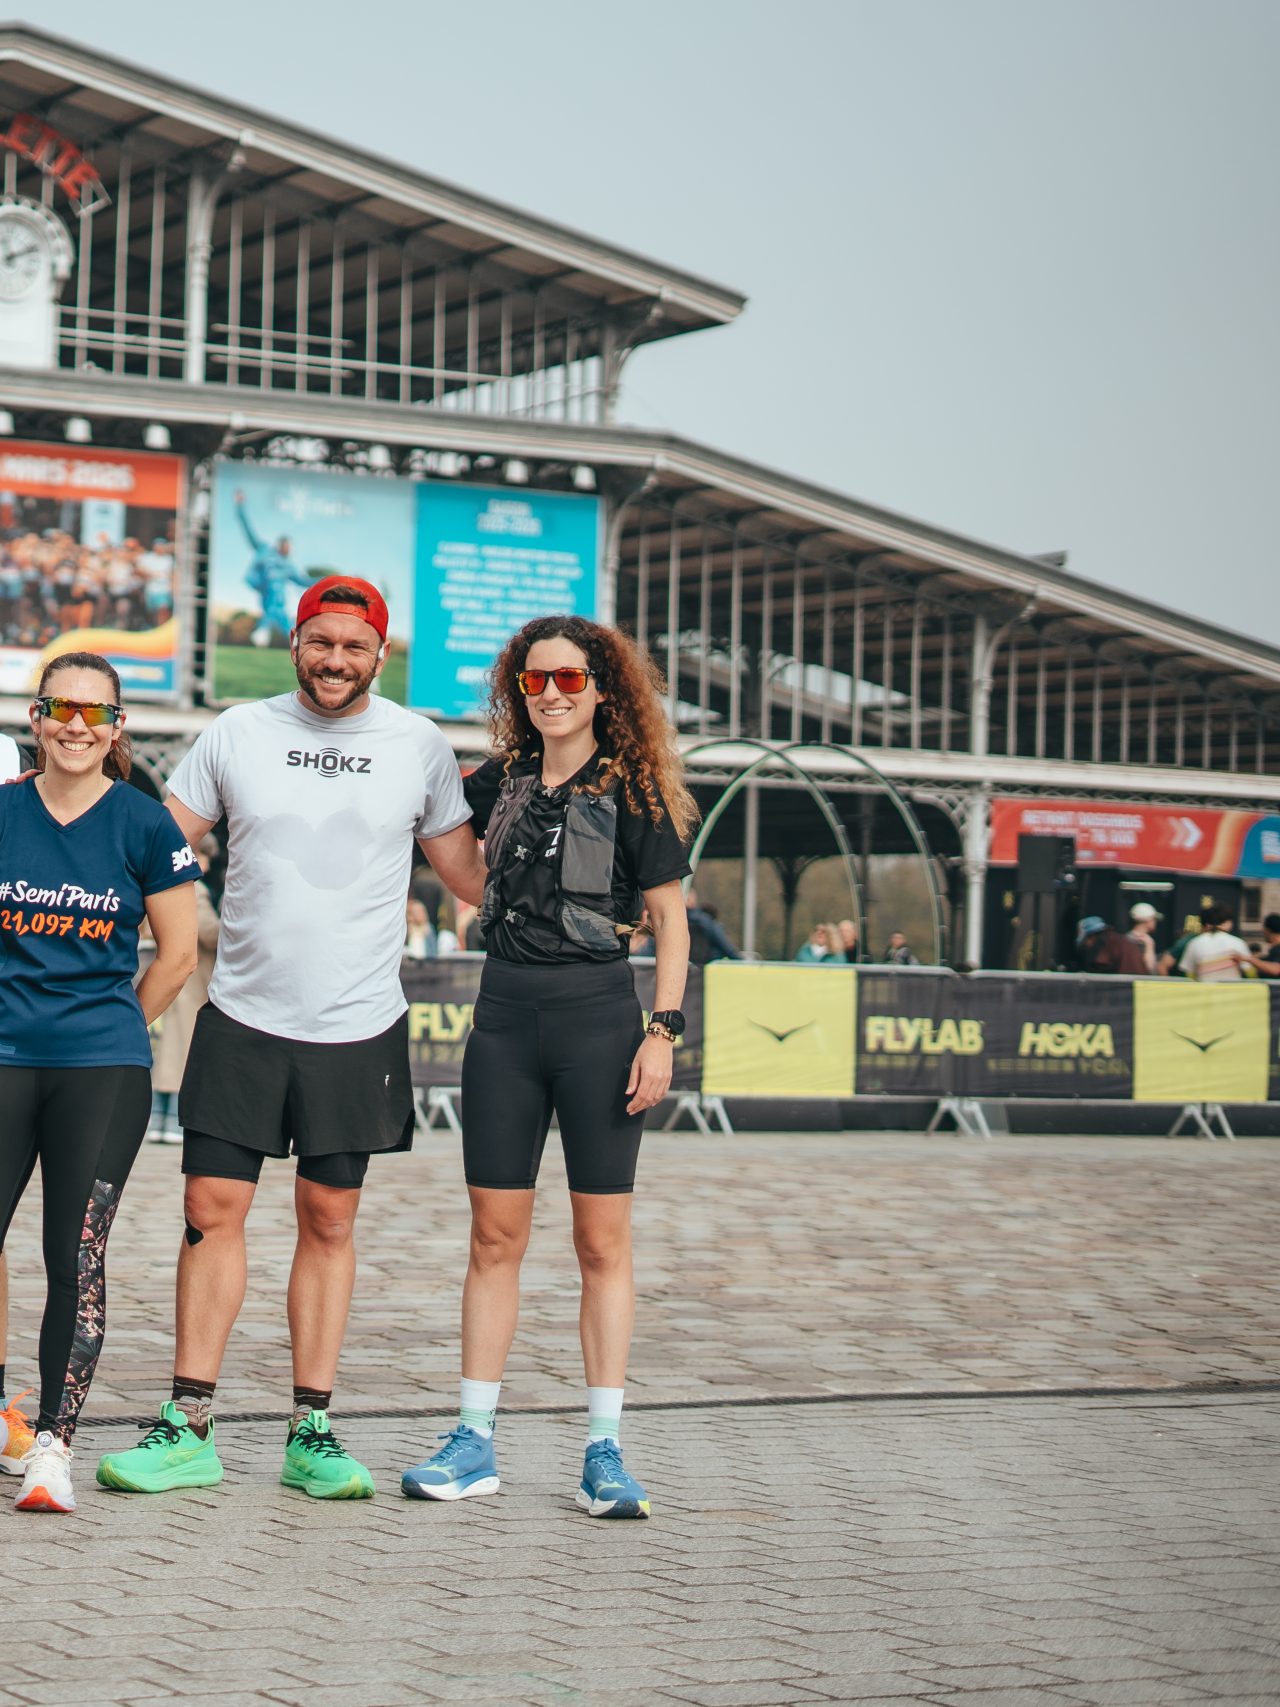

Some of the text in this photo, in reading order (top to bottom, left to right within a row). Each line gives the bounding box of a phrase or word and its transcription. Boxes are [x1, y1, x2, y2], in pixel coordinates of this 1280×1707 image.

[287, 749, 372, 776] SHOKZ
[1, 909, 115, 942] 21,097 KM
[407, 1002, 474, 1041] FLY
[865, 1016, 984, 1056] FLYLAB
[1019, 1022, 1115, 1057] HOKA
